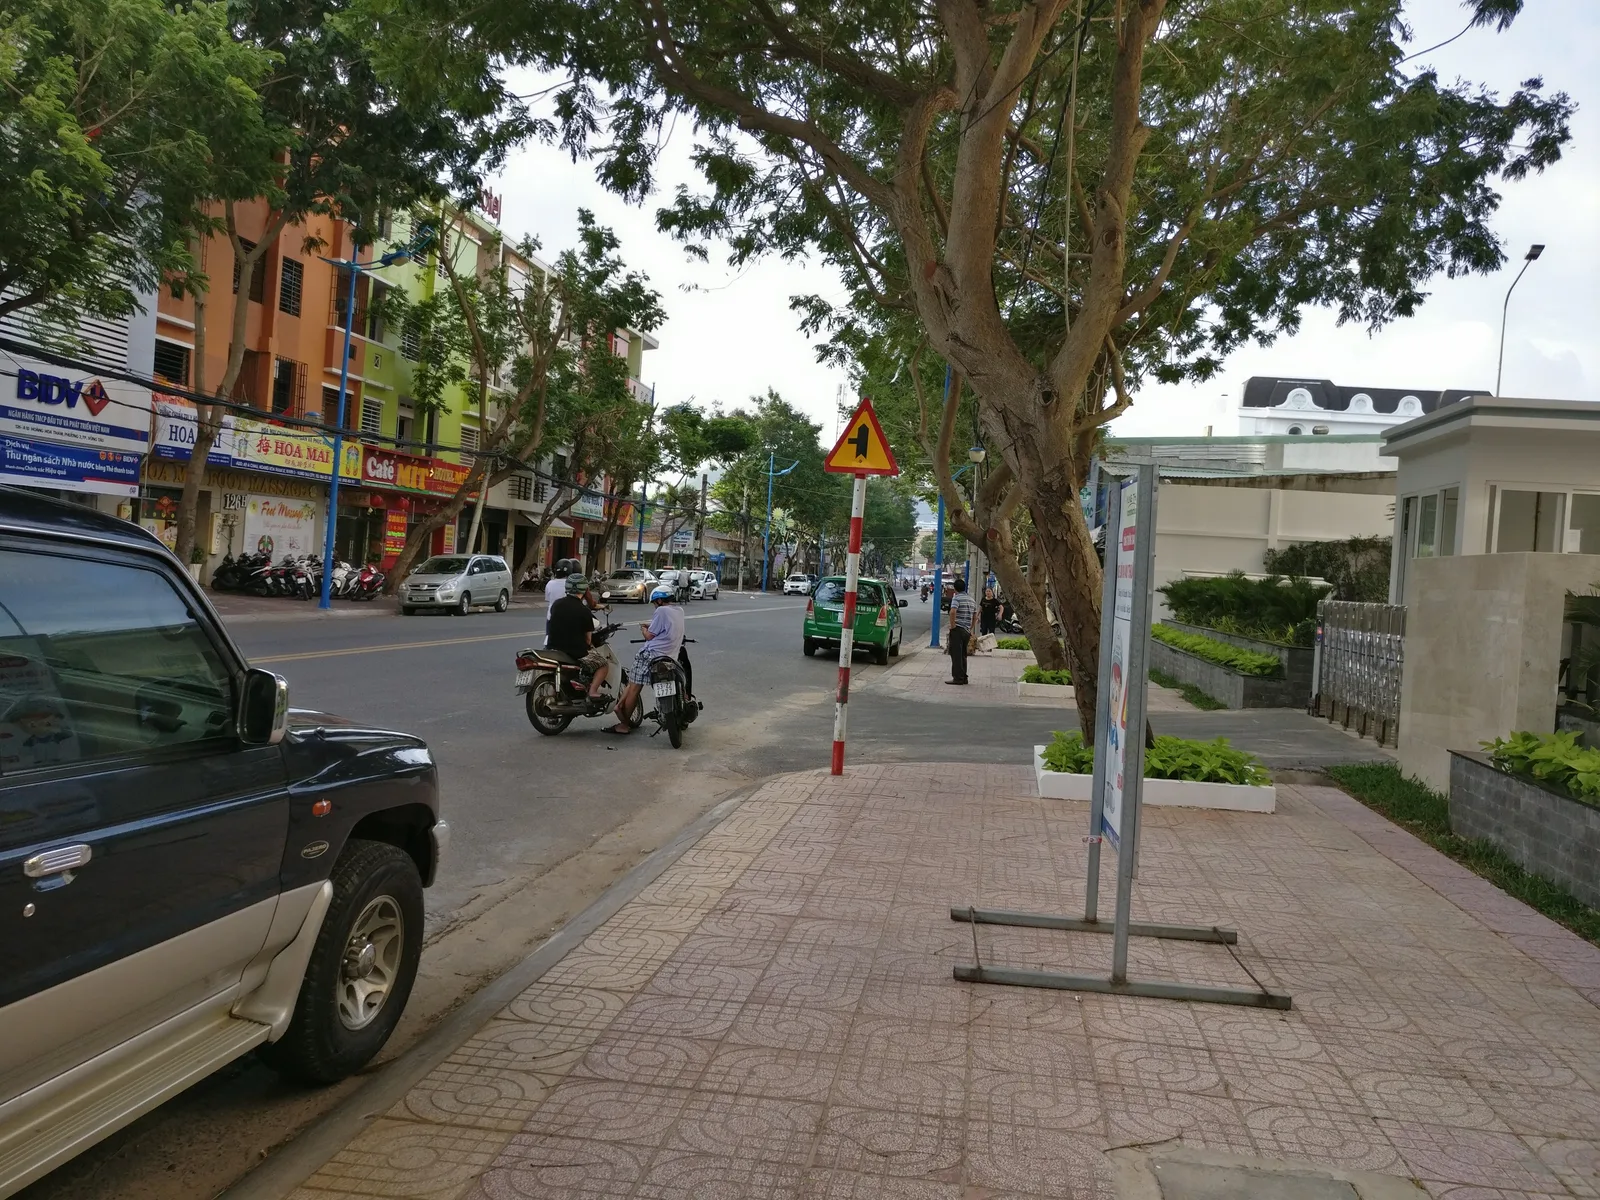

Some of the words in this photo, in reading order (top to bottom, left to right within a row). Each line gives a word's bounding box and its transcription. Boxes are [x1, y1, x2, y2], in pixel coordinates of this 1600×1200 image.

[17, 369, 83, 408] BIDV
[8, 409, 21, 419] NGÂN
[22, 411, 35, 422] HÀNG
[35, 414, 46, 423] TMCP
[64, 419, 69, 427] VÀ
[70, 420, 80, 429] PHÁT
[168, 424, 197, 445] HOA
[5, 440, 20, 448] Dịch
[20, 442, 30, 450] vụ
[274, 440, 303, 459] HOA
[306, 446, 331, 464] MAI
[5, 450, 21, 460] Thu
[22, 453, 42, 464] ngân
[43, 454, 60, 465] sách
[61, 457, 76, 468] Nhà
[78, 460, 95, 470] nước
[366, 456, 395, 480] Café
[207, 470, 246, 491] FOOT
[223, 493, 247, 510] 126H
[303, 844, 326, 854] PAJERO
